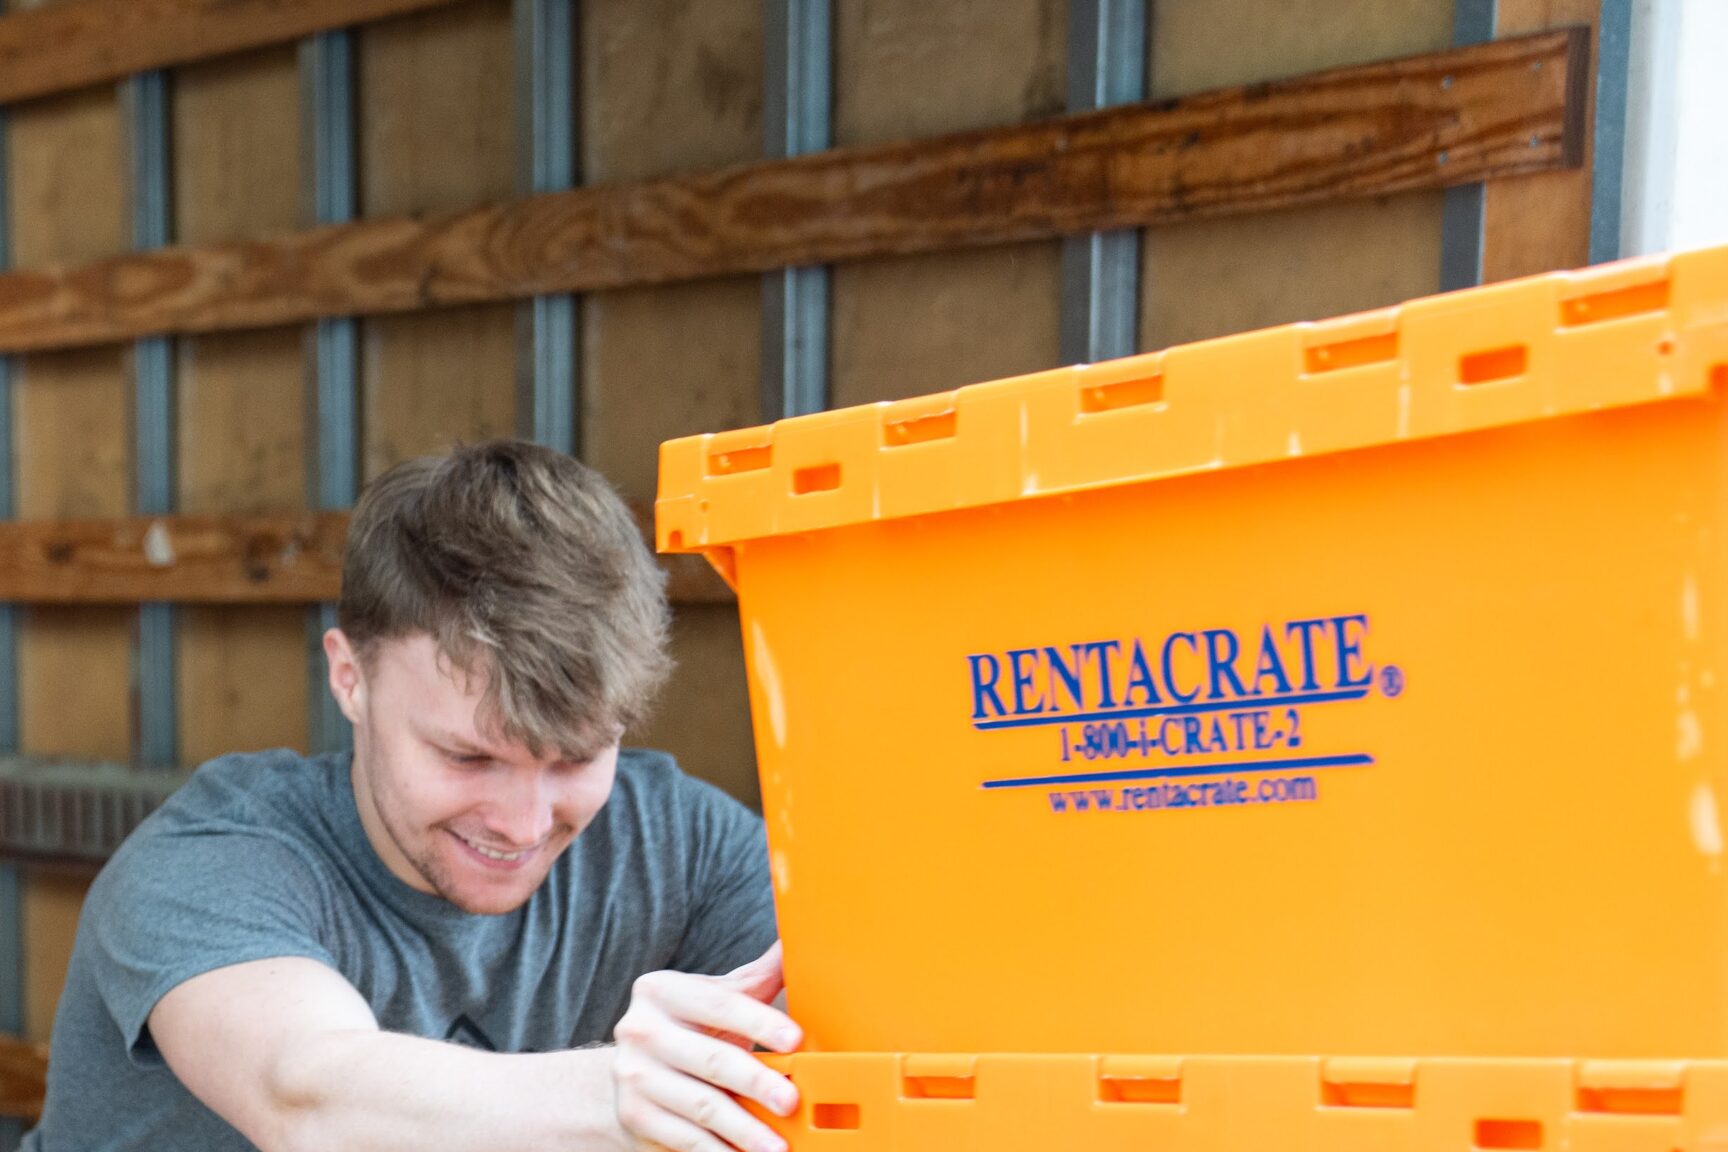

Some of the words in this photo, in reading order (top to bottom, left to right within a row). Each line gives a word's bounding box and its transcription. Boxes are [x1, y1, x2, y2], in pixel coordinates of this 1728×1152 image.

[967, 613, 1374, 719] RENTACRATE
[1059, 709, 1302, 762] 1-800-i-CRATE-2
[1048, 774, 1318, 813] www.rentacrate.com
